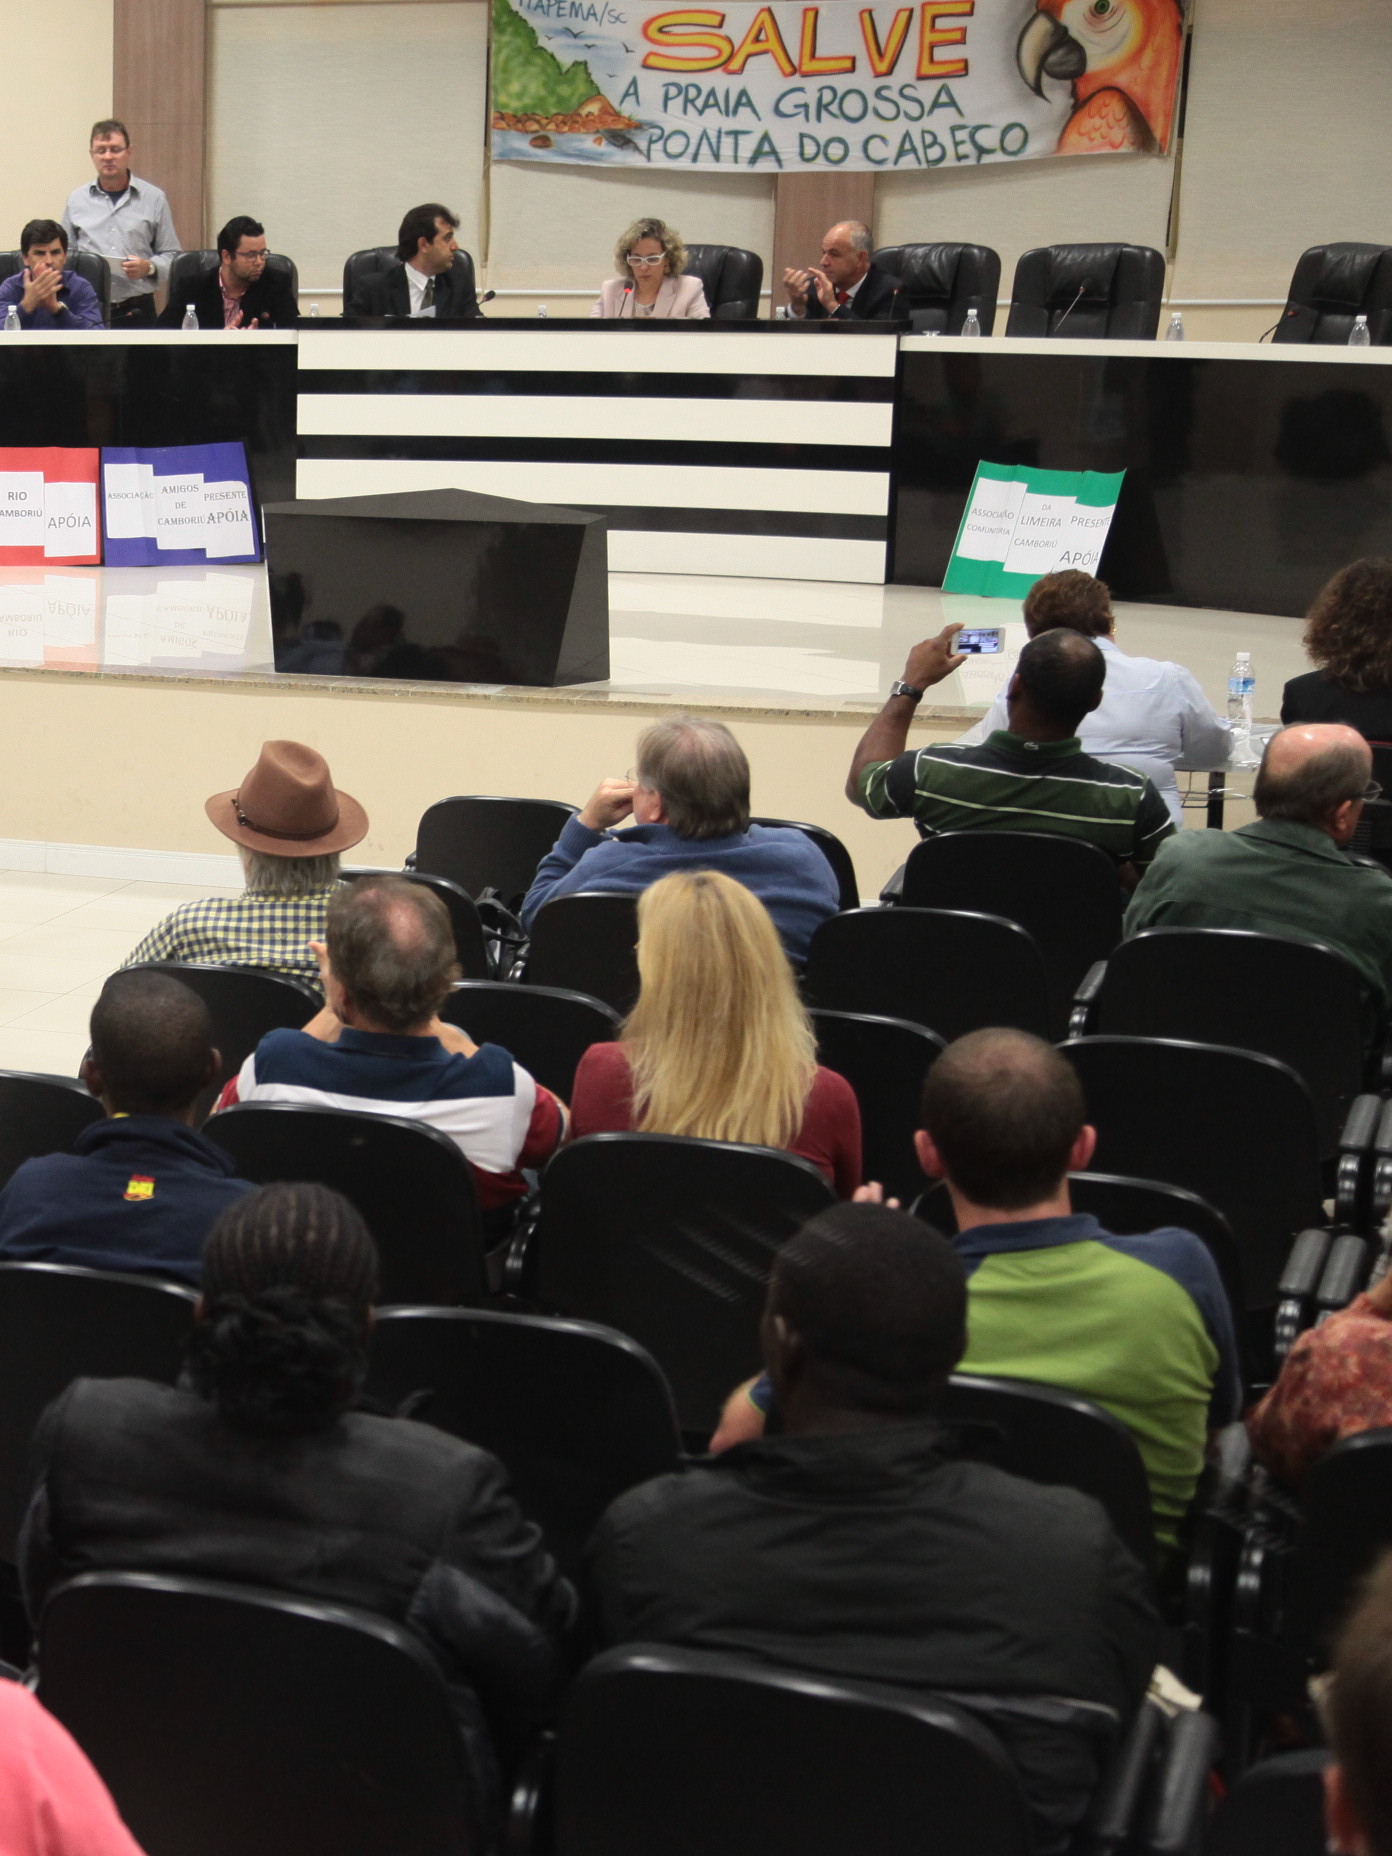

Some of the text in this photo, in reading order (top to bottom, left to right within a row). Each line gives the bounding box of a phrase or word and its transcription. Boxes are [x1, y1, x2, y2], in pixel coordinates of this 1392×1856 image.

[642, 1, 974, 79] SALVE
[619, 77, 965, 123] A PRAIA GROSSA
[644, 123, 1030, 168] PONTA DO CABEÇO
[8, 491, 27, 500] RIO
[161, 484, 199, 495] AMIGOS
[203, 490, 247, 502] PRESENTE
[175, 501, 187, 510] DE
[47, 513, 92, 529] APÓIA
[206, 508, 249, 525] APÓIA
[1020, 515, 1062, 528] LIMEIRA
[1070, 515, 1111, 529] PRESENTE
[1059, 550, 1099, 566] APÓIA
